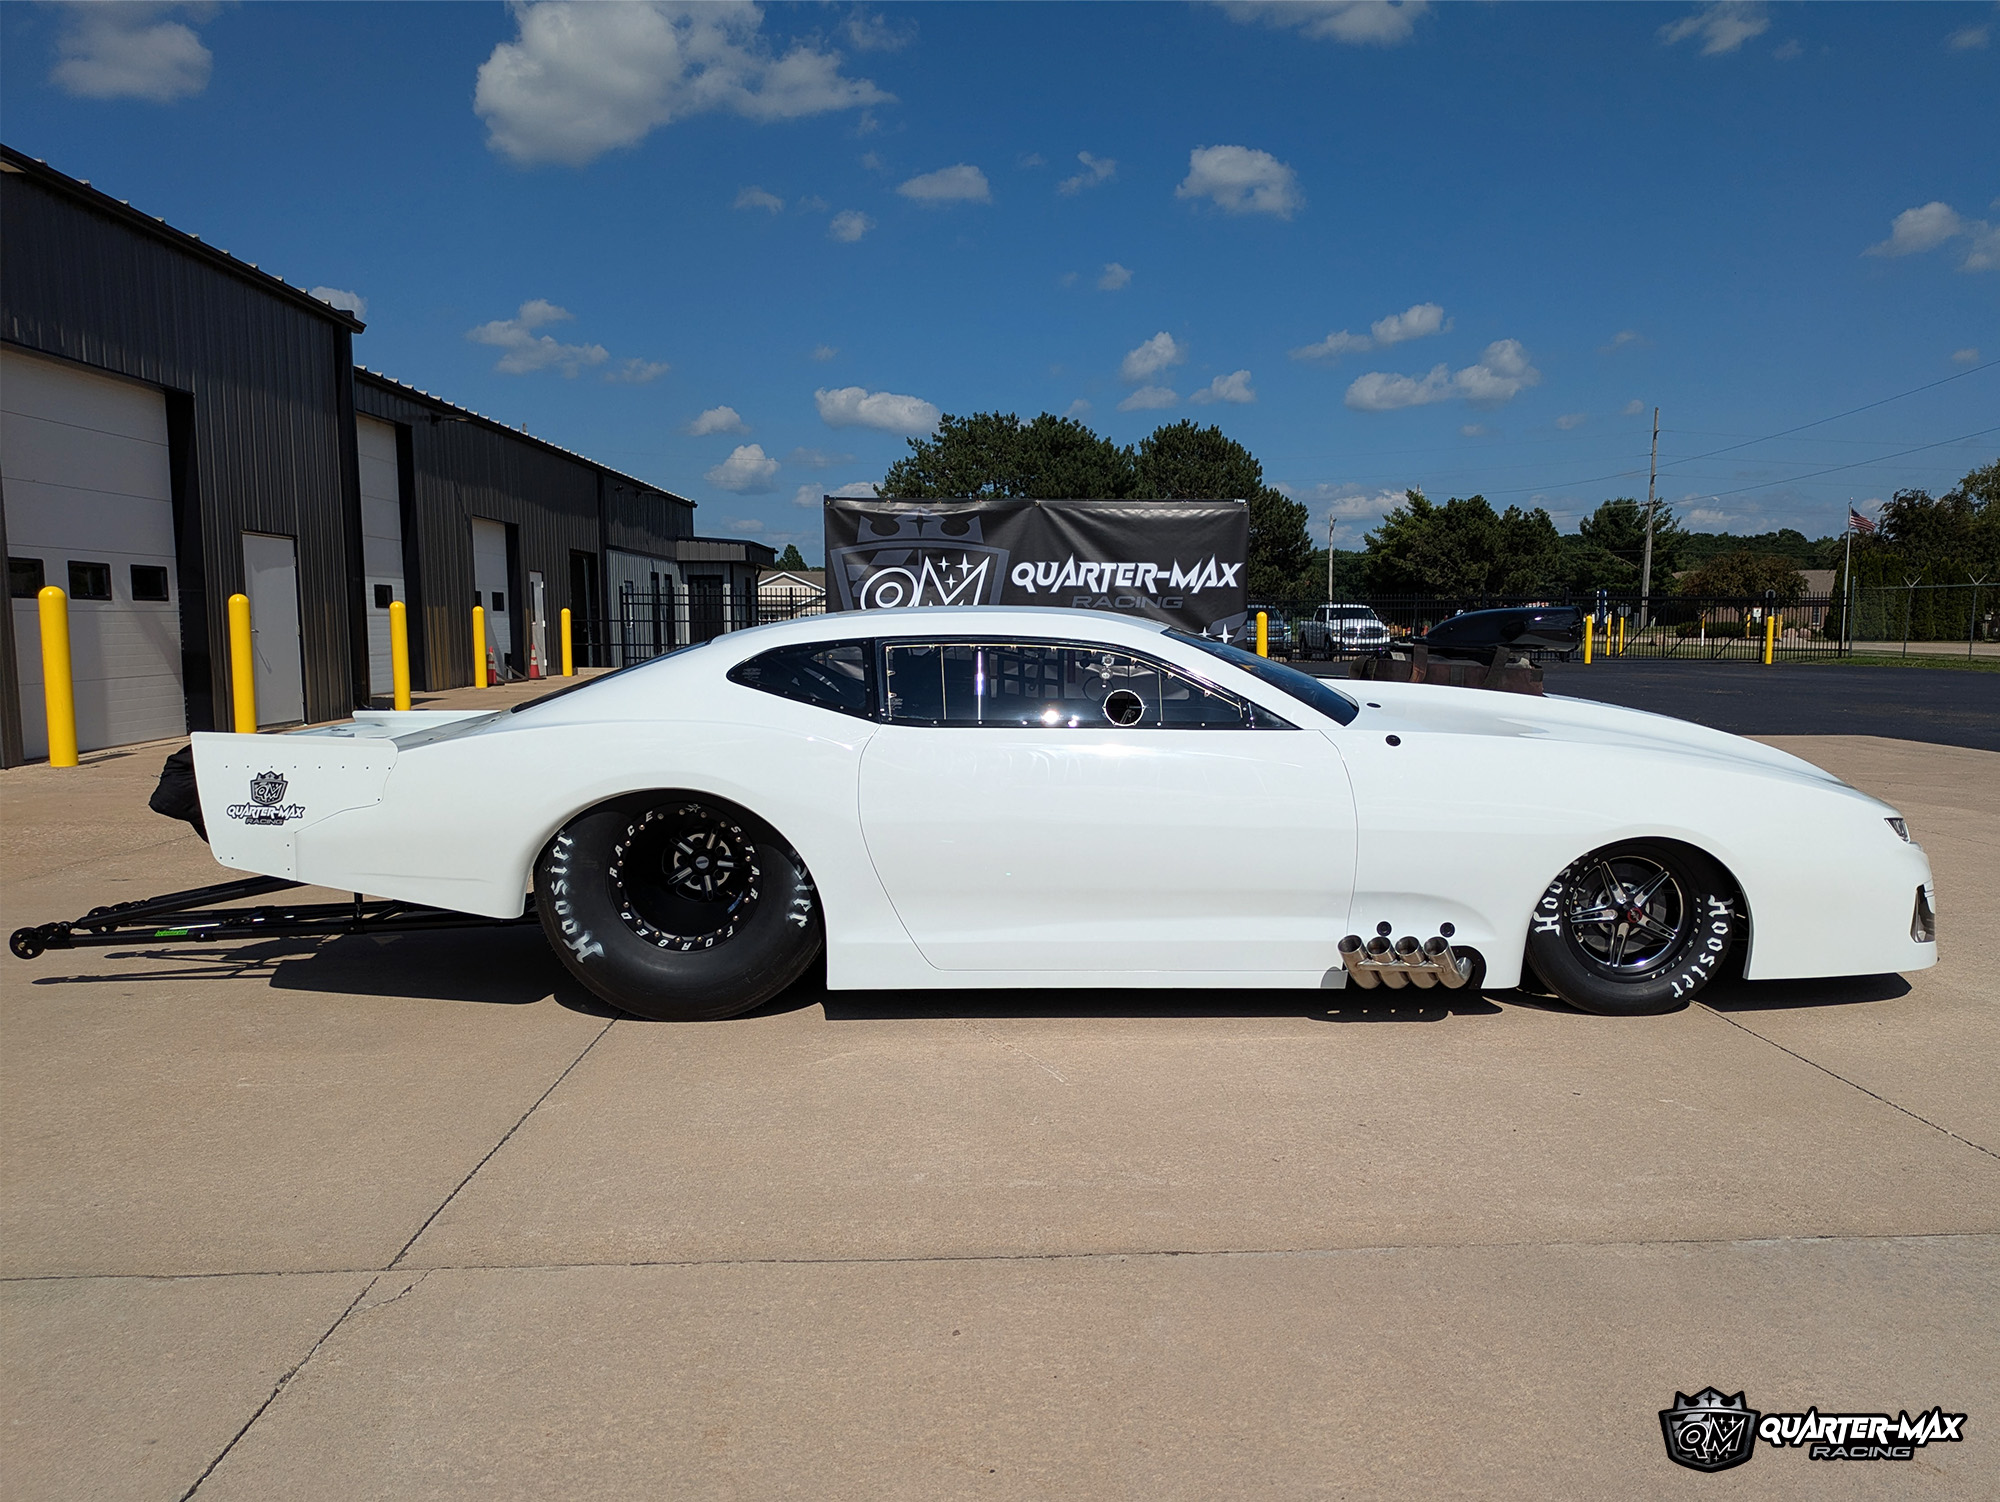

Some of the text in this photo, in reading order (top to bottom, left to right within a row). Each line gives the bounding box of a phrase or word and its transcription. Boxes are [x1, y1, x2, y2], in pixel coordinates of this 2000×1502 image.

[1011, 552, 1245, 594] QUARTER-MAX
[1071, 596, 1184, 609] RACING
[226, 803, 305, 819] QUARTER-MAX
[609, 811, 760, 899] RACE STAR
[620, 912, 734, 950] FORGED
